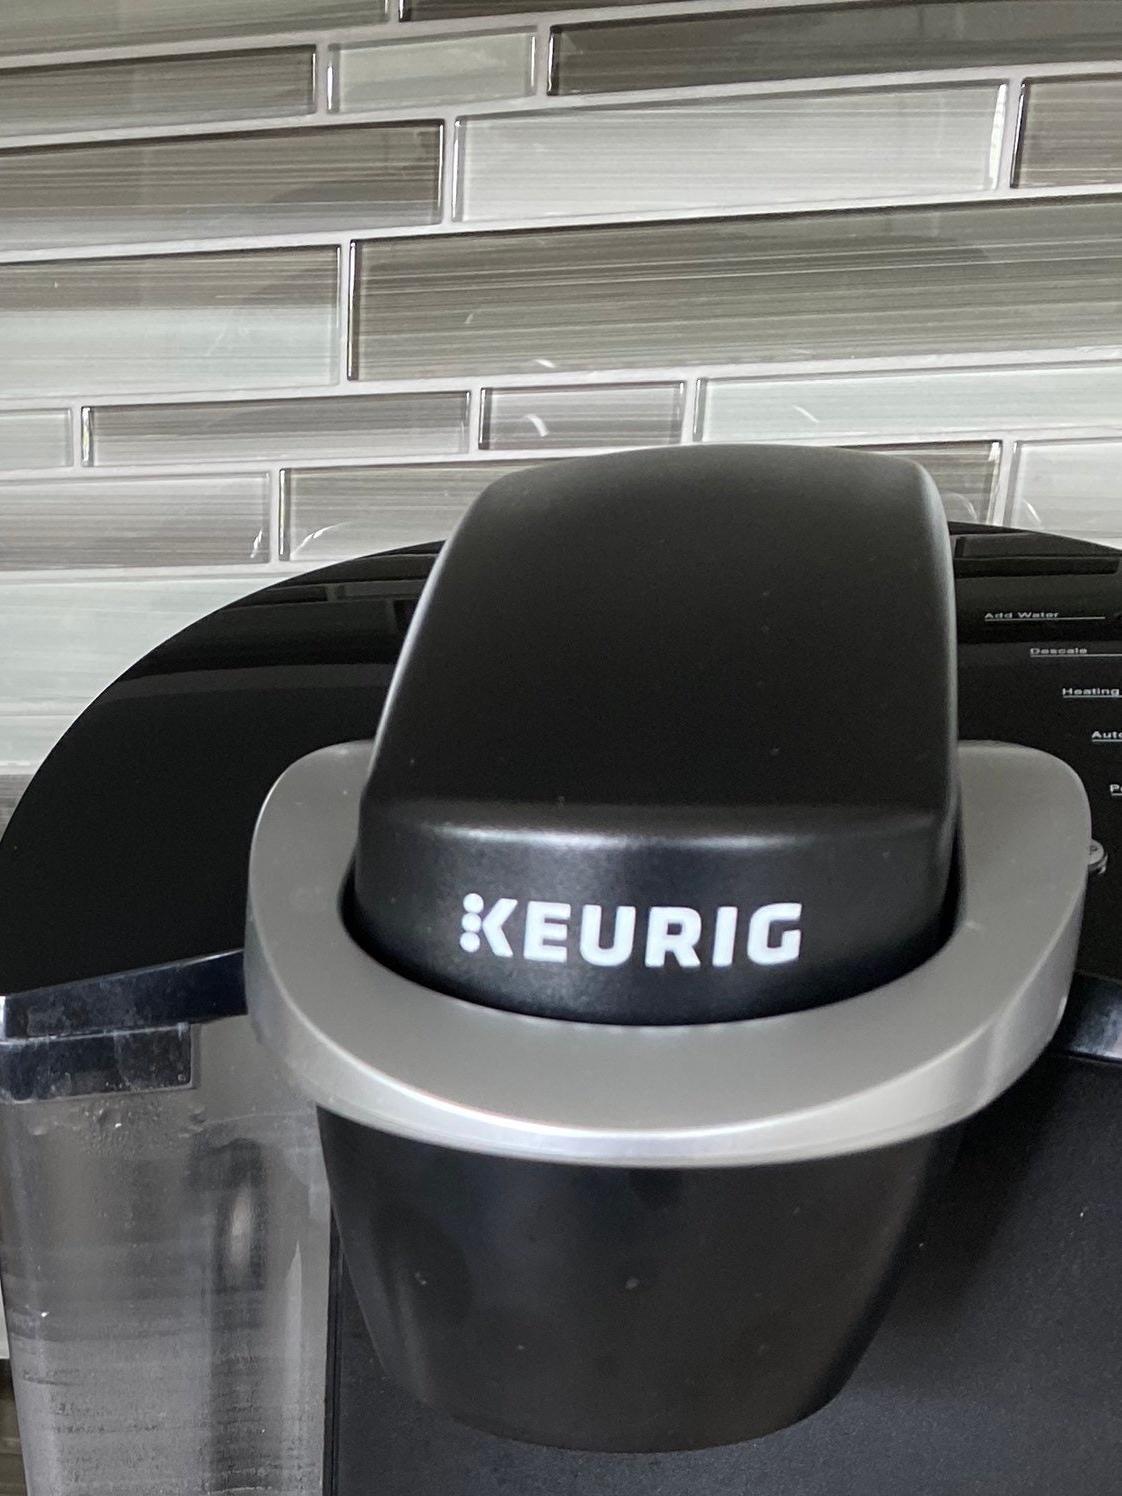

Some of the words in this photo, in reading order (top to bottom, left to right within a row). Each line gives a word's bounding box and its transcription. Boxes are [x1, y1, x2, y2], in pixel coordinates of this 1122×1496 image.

[1017, 611, 1059, 619] Water
[1030, 647, 1088, 655] Descale
[1061, 687, 1120, 697] Heating
[460, 892, 803, 968] KEURIG
